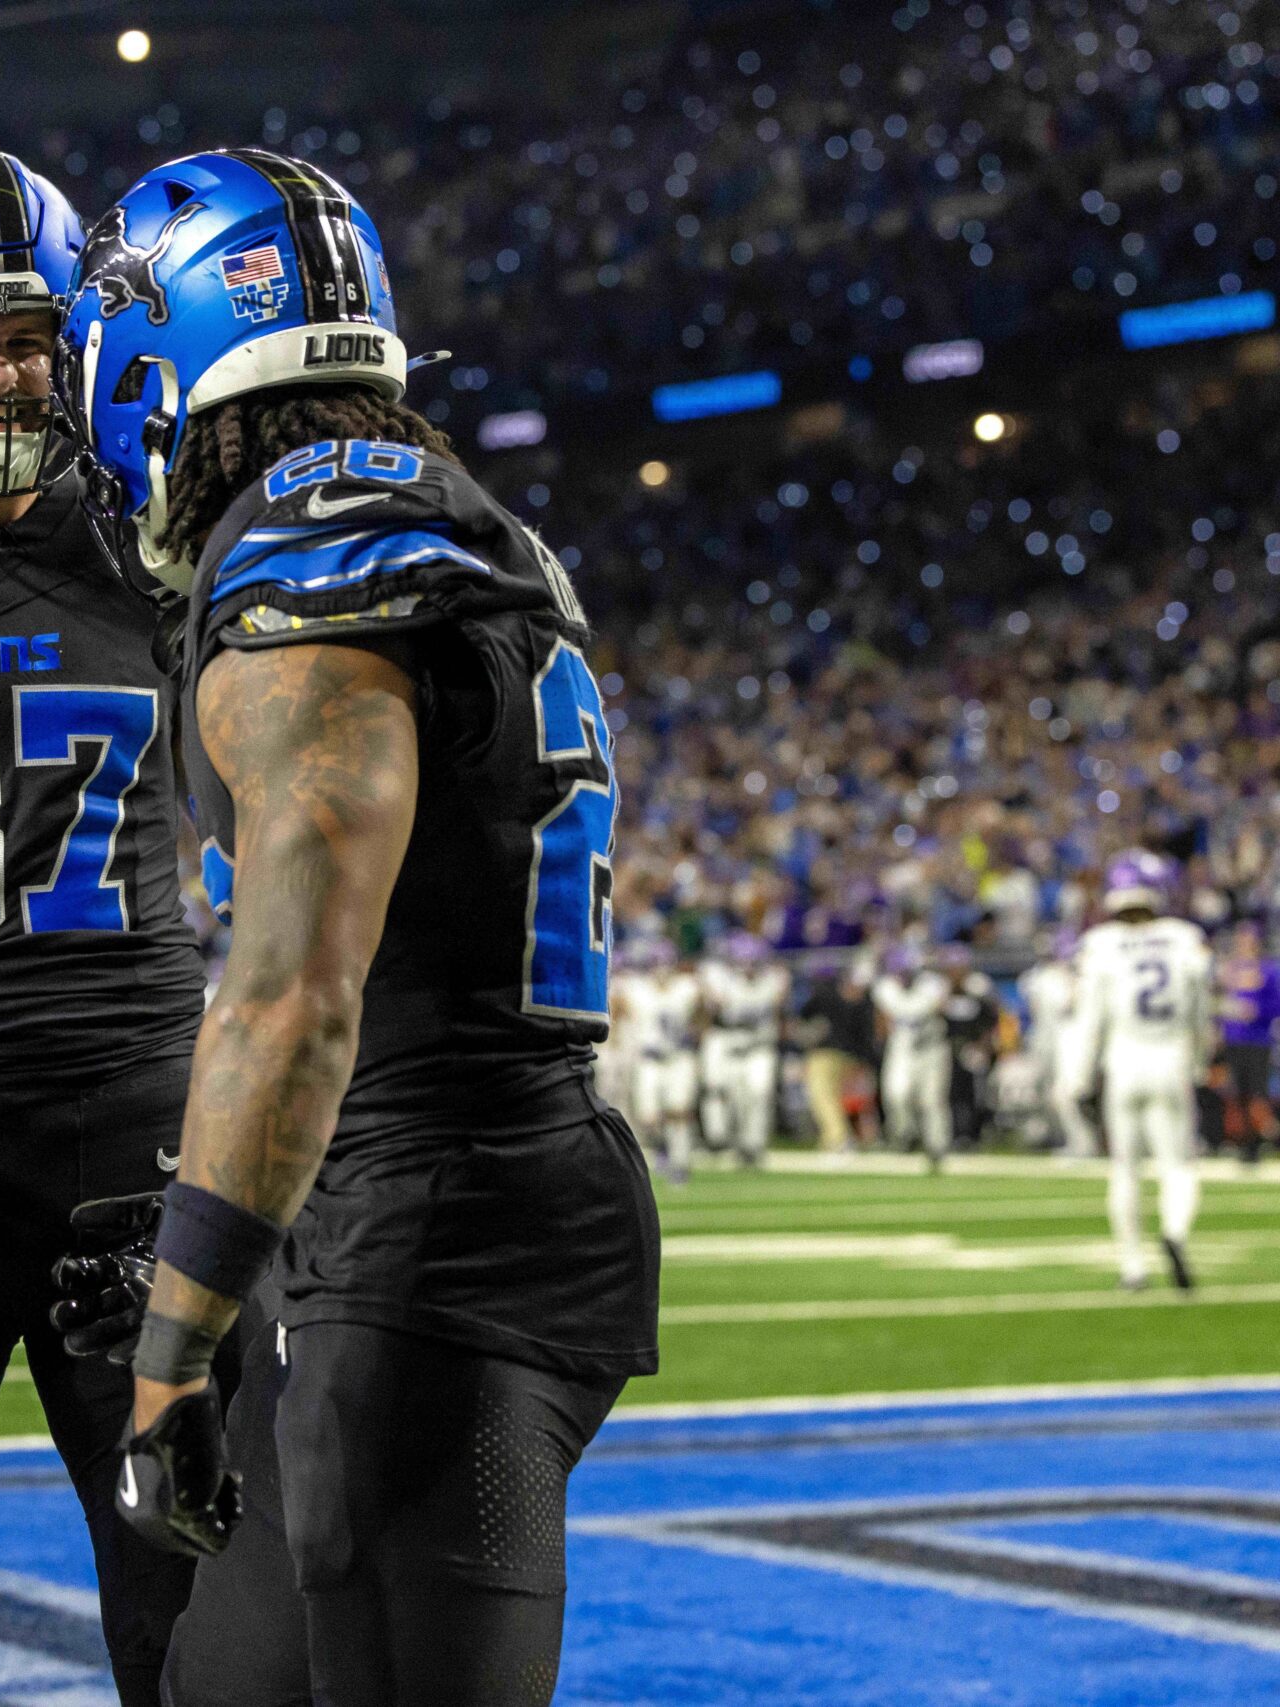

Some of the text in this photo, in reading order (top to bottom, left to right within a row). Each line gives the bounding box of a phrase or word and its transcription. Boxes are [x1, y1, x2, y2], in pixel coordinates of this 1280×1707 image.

[231, 283, 290, 319] WCF
[324, 282, 358, 301] 26
[304, 332, 386, 370] LIONS
[263, 438, 425, 504] 26
[1135, 960, 1174, 1021] 2
